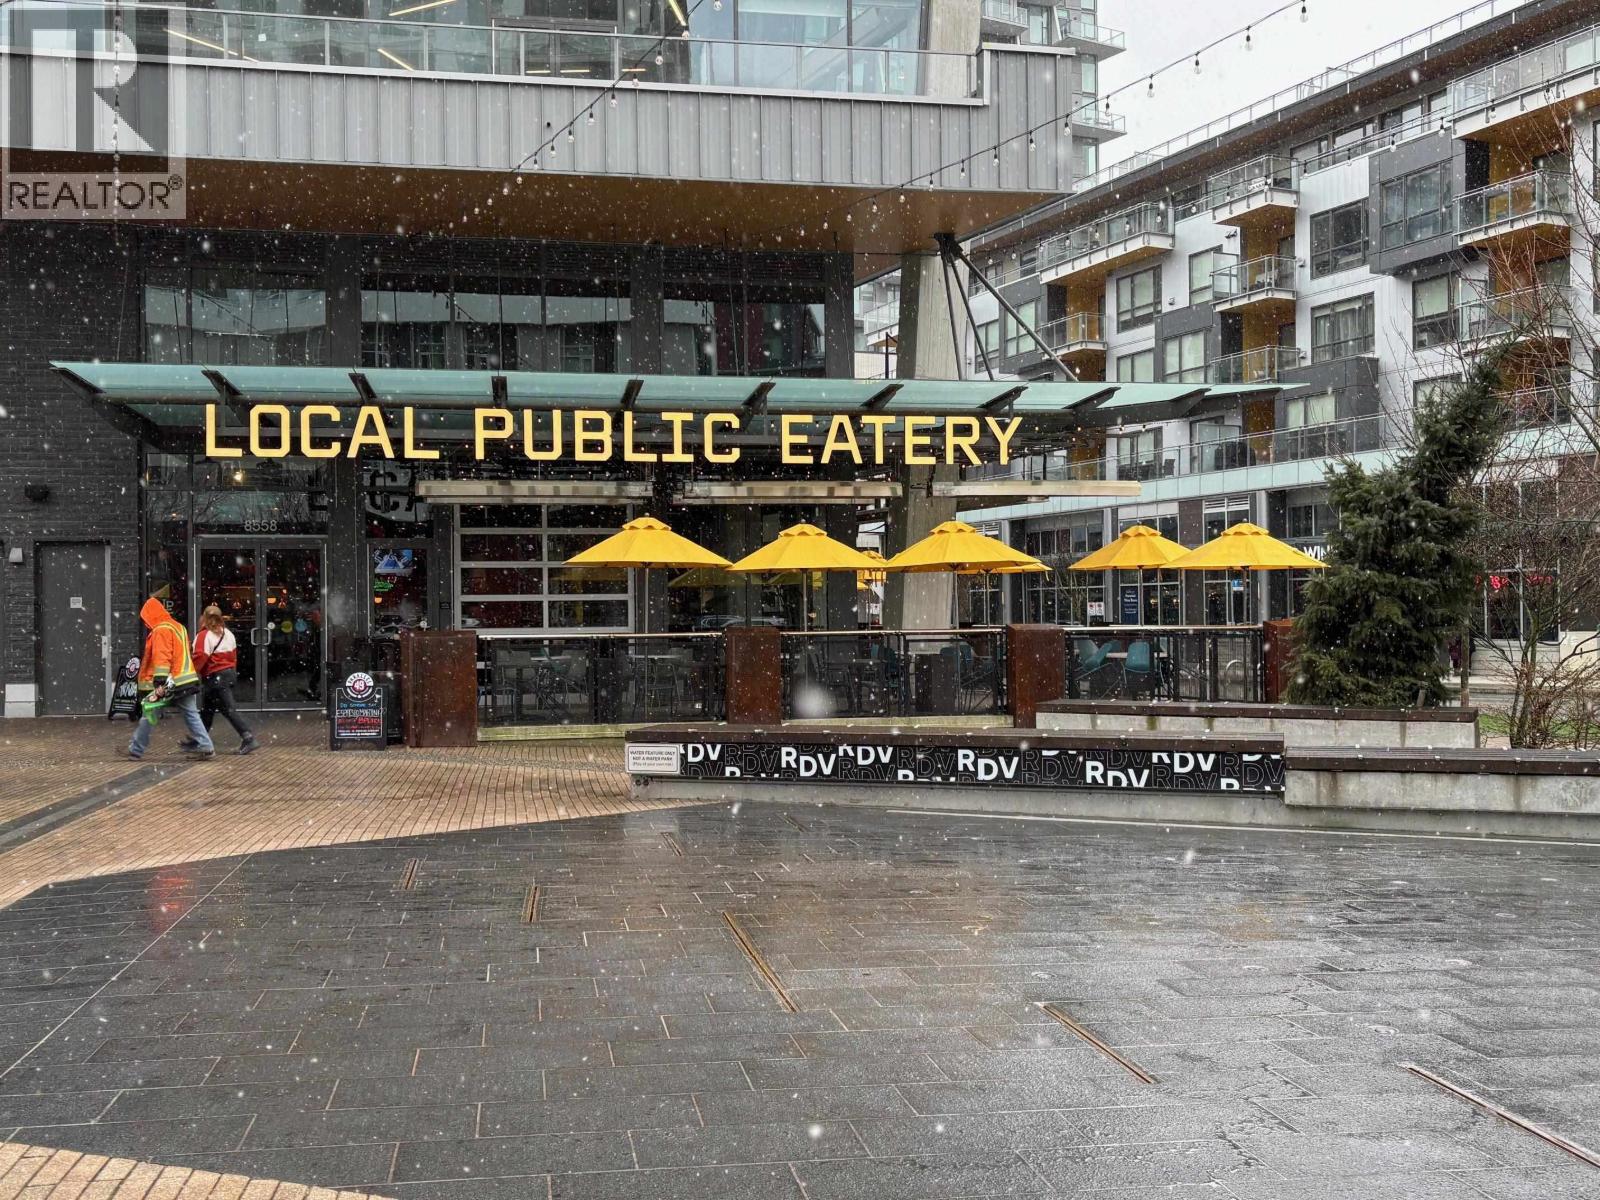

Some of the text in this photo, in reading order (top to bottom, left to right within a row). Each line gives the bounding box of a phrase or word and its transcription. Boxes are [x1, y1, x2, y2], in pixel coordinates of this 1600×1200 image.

[205, 403, 1023, 465] LOCAL PUBLIC EATERY
[244, 519, 278, 531] 8558
[354, 680, 365, 691] 49
[781, 746, 836, 777] RDV
[957, 749, 1019, 780] RDV
[1085, 760, 1150, 788] RDV
